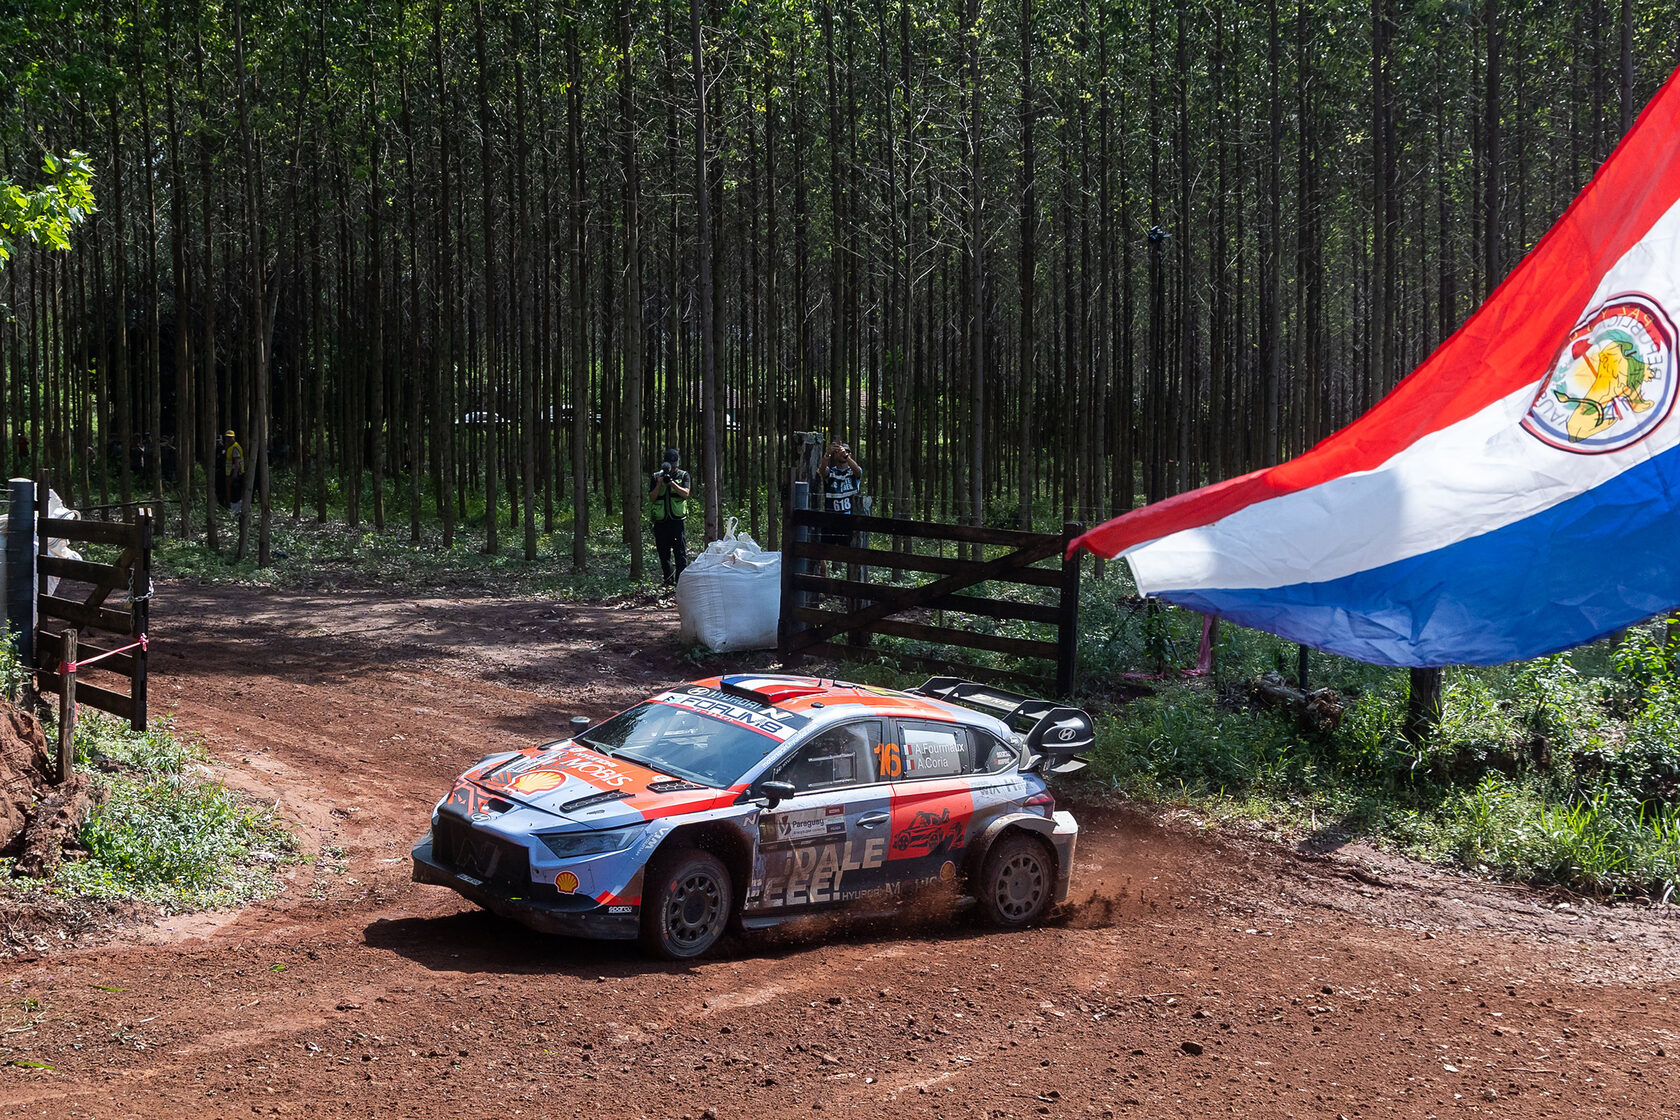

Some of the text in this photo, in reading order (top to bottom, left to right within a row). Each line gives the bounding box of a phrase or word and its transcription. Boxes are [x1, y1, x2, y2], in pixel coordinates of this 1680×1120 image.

[915, 742, 965, 756] A.Fourmaux
[873, 743, 902, 777] 16
[917, 757, 949, 770] A.Coria
[562, 758, 634, 787] MOBIS
[792, 818, 825, 831] Paraguay
[607, 905, 633, 914] sparco
